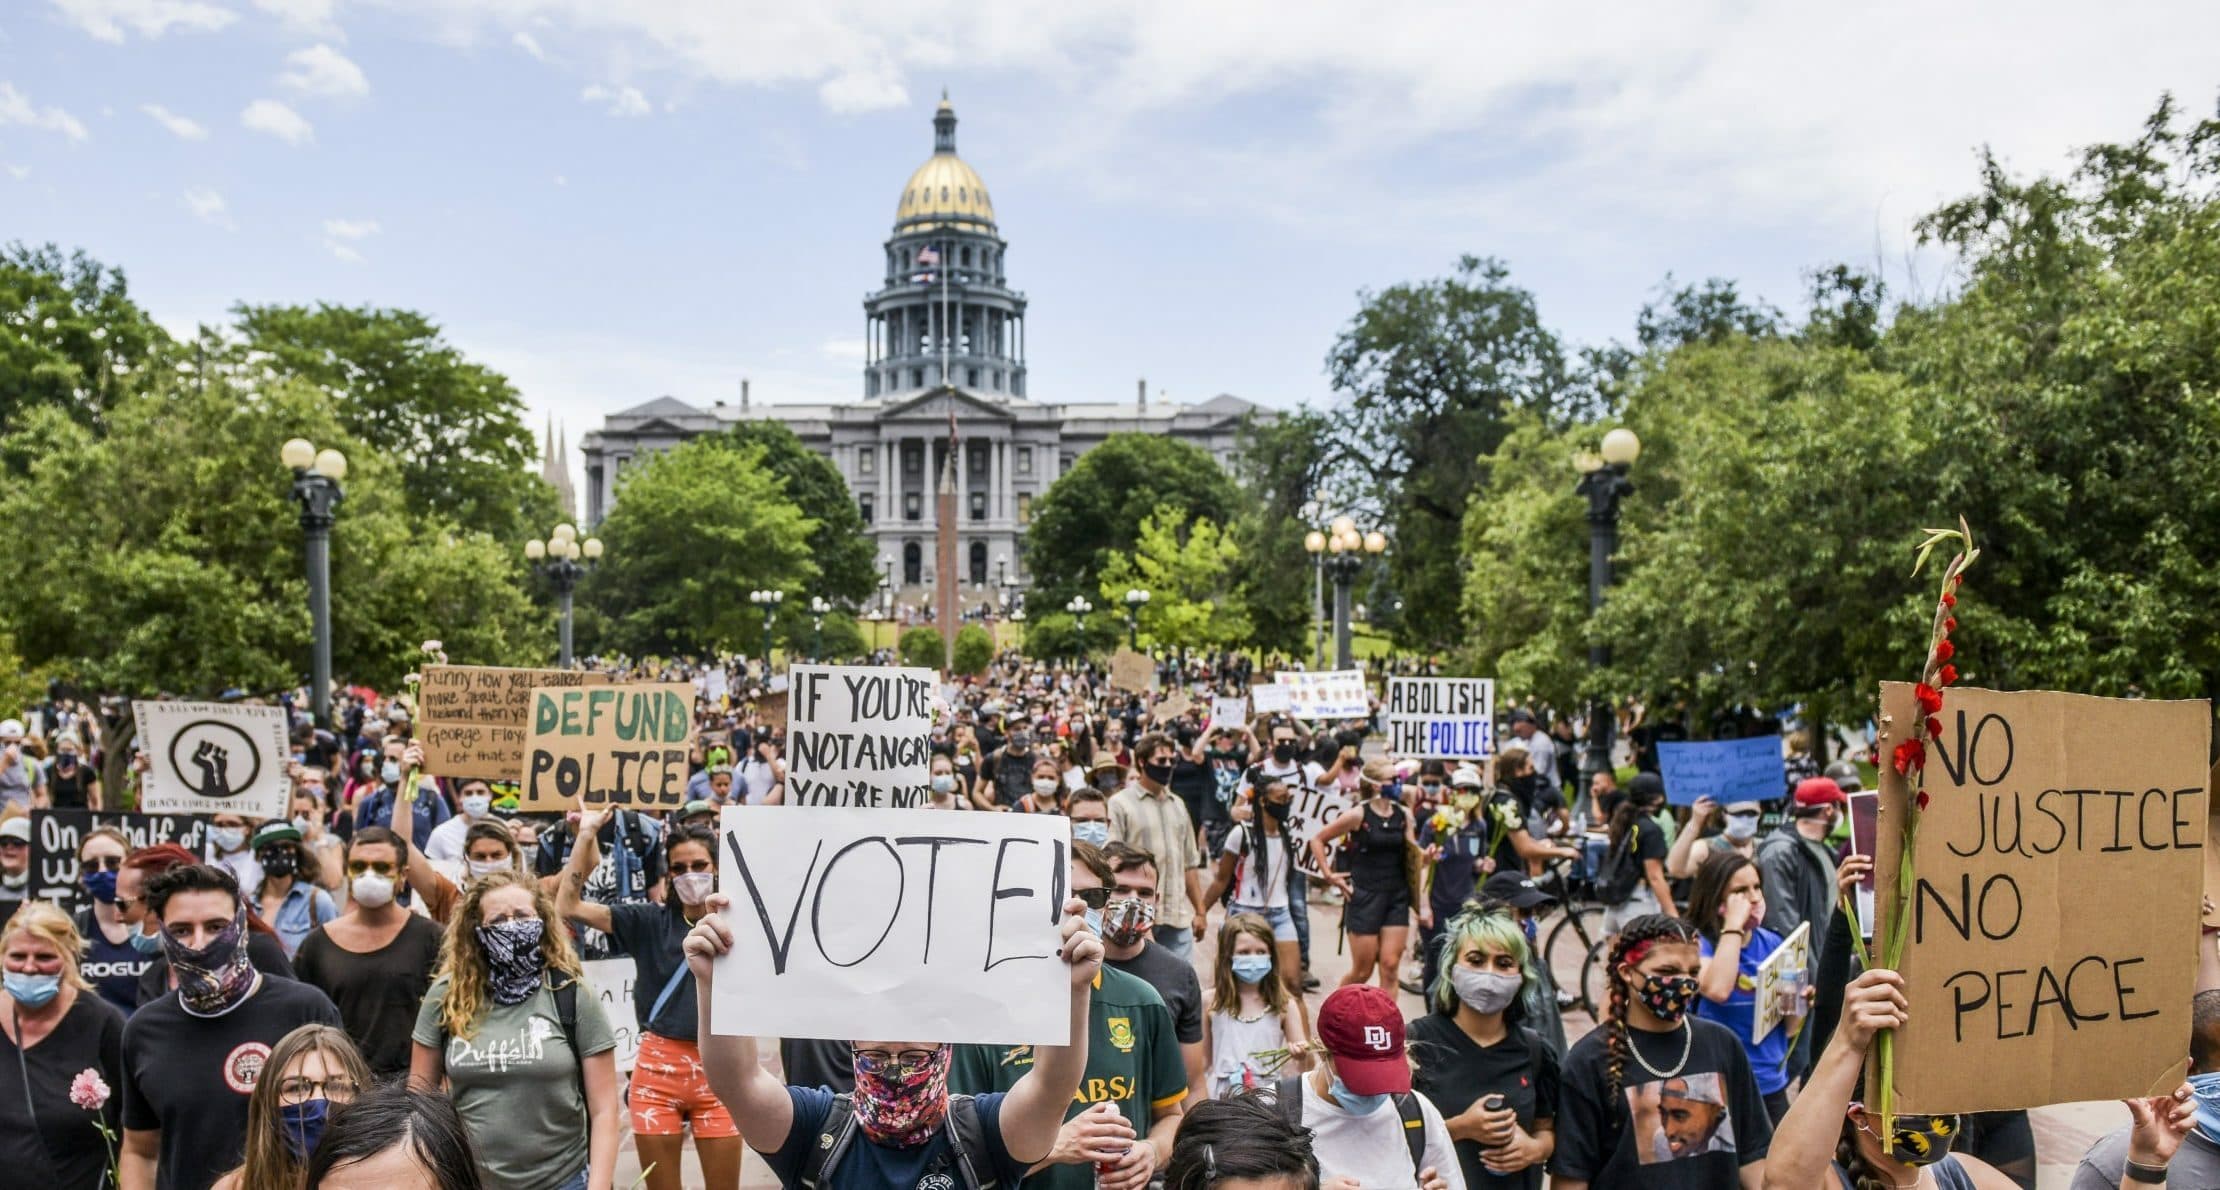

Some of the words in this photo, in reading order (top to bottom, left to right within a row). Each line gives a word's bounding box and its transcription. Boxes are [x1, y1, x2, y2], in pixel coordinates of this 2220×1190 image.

[422, 669, 472, 693] Funny
[541, 672, 584, 687] talked
[795, 672, 829, 722] IF
[843, 674, 930, 723] YOU'RE
[1391, 682, 1485, 715] ABOLISH
[536, 690, 688, 743] DEFUND
[1391, 721, 1426, 754] THE
[1430, 721, 1489, 755] POLICE
[791, 731, 854, 773] NOT
[853, 733, 932, 771] ANGRY
[1918, 710, 2013, 787] NO
[529, 749, 685, 805] POLICE
[790, 777, 883, 808] YOU'RE
[891, 784, 931, 808] NOT
[41, 815, 79, 853] On
[180, 820, 205, 849] of
[1947, 788, 2203, 858] JUSTICE
[726, 830, 1065, 976] VOTE!
[1916, 873, 2022, 944] NO
[81, 961, 152, 977] ROGU
[1943, 956, 2160, 1042] PEACE
